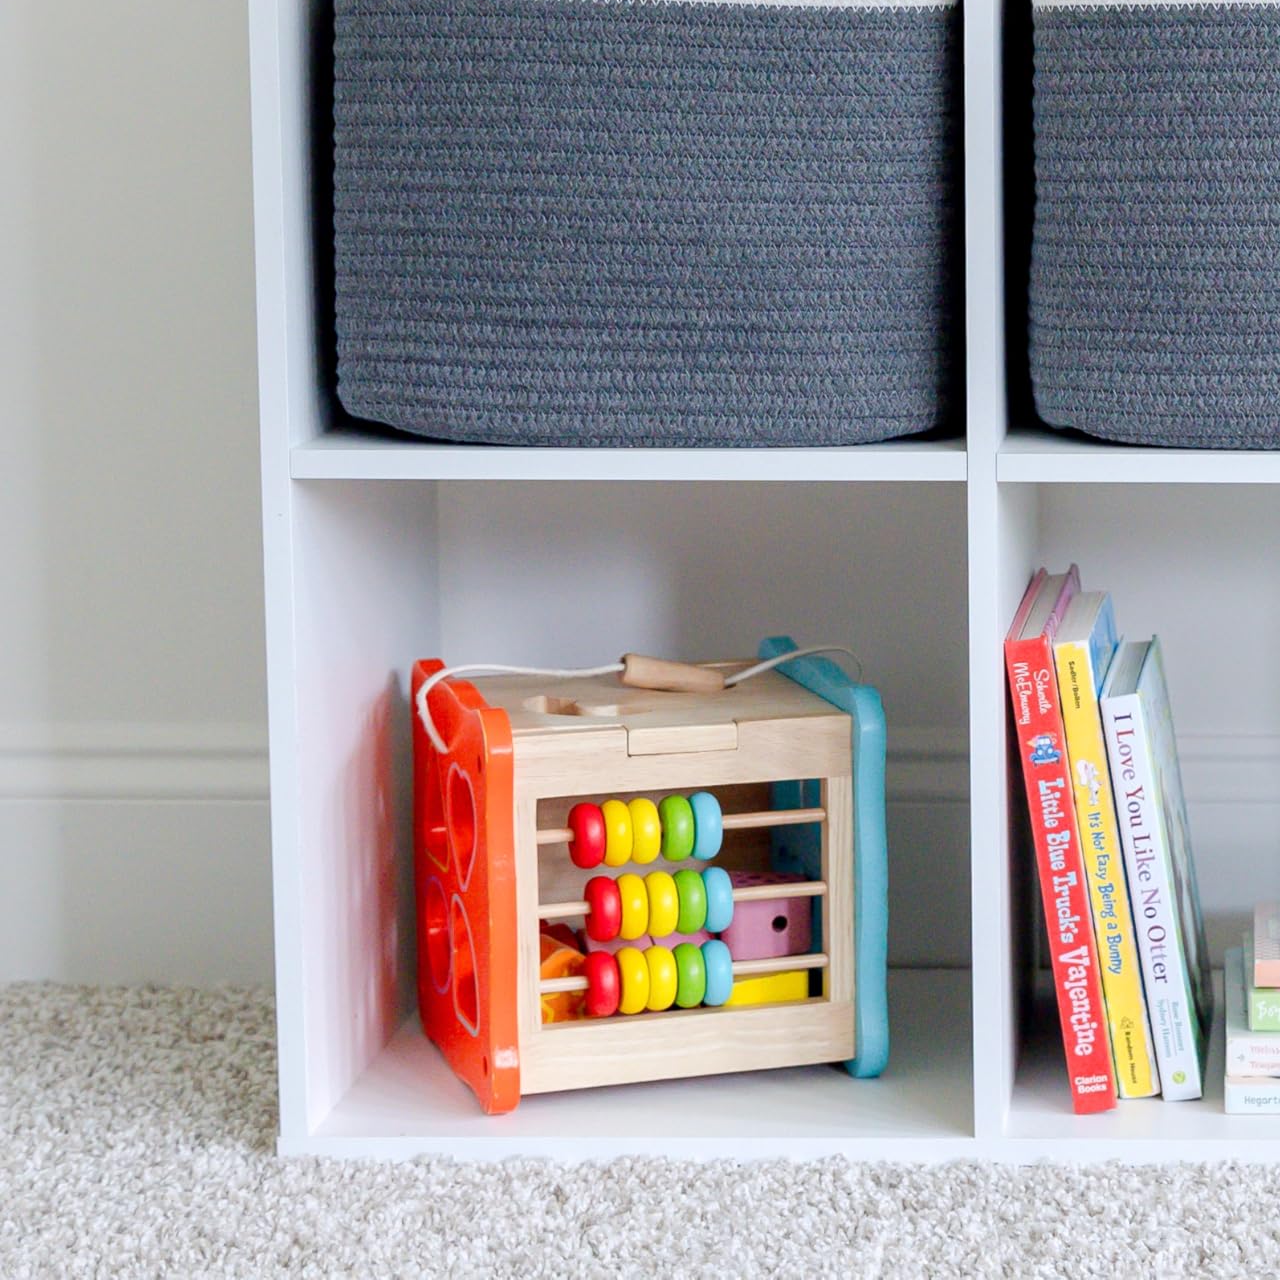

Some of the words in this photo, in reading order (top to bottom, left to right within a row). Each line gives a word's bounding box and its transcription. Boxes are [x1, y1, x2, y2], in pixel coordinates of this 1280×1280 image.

[1113, 711, 1133, 723] I
[1115, 728, 1136, 781] Love
[1038, 777, 1065, 829] Little
[1088, 811, 1103, 828] It's
[1125, 785, 1145, 828] You
[1046, 829, 1071, 872] Blue
[1091, 831, 1106, 852] Not
[1132, 833, 1156, 883] Like
[1096, 853, 1110, 880] Easy
[1052, 871, 1081, 944] Truck's
[1098, 882, 1117, 919] Being
[1141, 887, 1162, 919] No
[1106, 922, 1118, 930] a
[1106, 933, 1122, 975] Bunny
[1147, 925, 1168, 984] Otter
[1058, 945, 1098, 1057] Valentine
[1074, 1074, 1108, 1086] Clarion
[1077, 1083, 1108, 1095] Books
